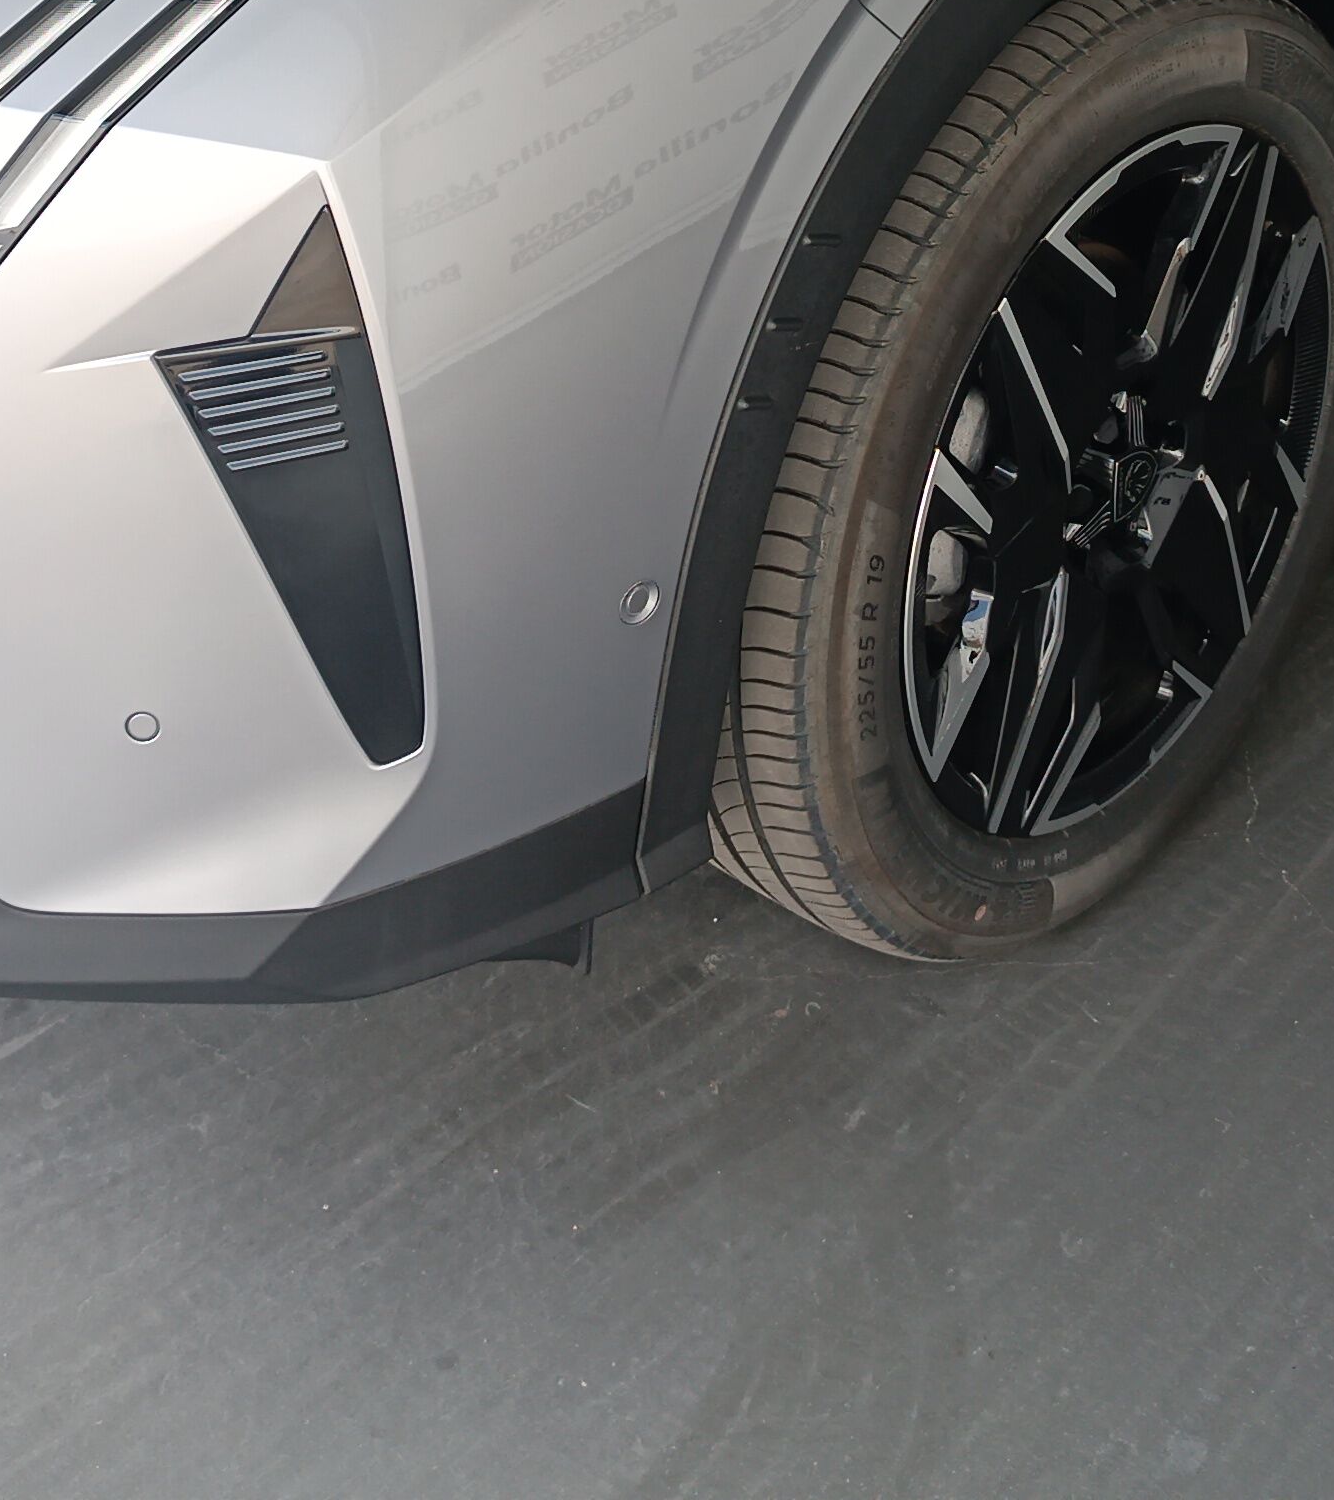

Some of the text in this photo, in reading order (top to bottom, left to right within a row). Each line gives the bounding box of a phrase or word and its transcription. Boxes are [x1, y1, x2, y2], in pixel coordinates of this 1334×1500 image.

[857, 554, 885, 742] 225/55 R 19
